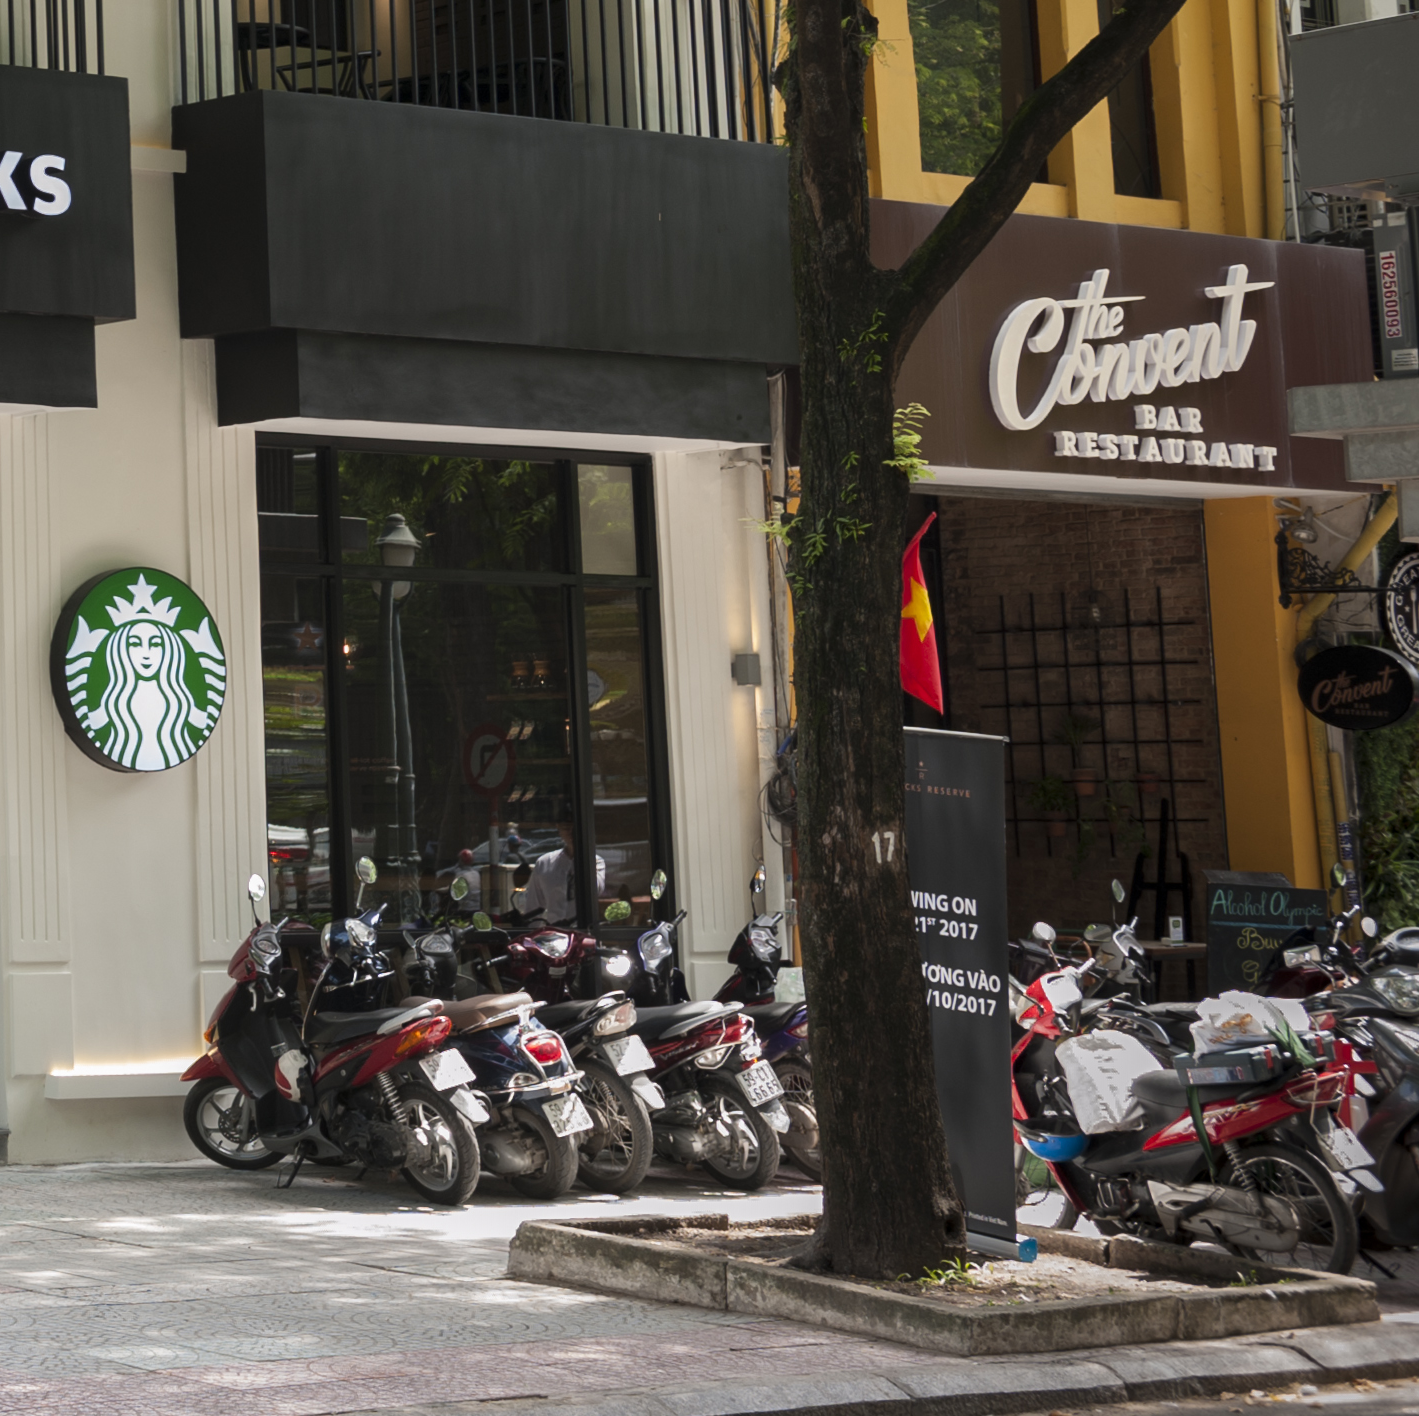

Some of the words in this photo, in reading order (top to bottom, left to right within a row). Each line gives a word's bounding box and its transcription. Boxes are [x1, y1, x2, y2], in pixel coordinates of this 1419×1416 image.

[1057, 268, 1146, 340] the
[1380, 252, 1401, 338] 162560093
[989, 263, 1275, 431] Convent
[1134, 404, 1203, 433] BAR
[1054, 430, 1277, 471] RESTAURANT
[1312, 666, 1398, 713] Convent
[927, 786, 971, 798] RESERVE
[871, 831, 895, 864] 17
[952, 897, 977, 916] ON
[1210, 889, 1265, 916] Alcohol
[1270, 891, 1324, 926] Olympic
[939, 919, 978, 940] 2017
[967, 969, 1000, 992] VÀO
[927, 989, 996, 1016] /10/2017
